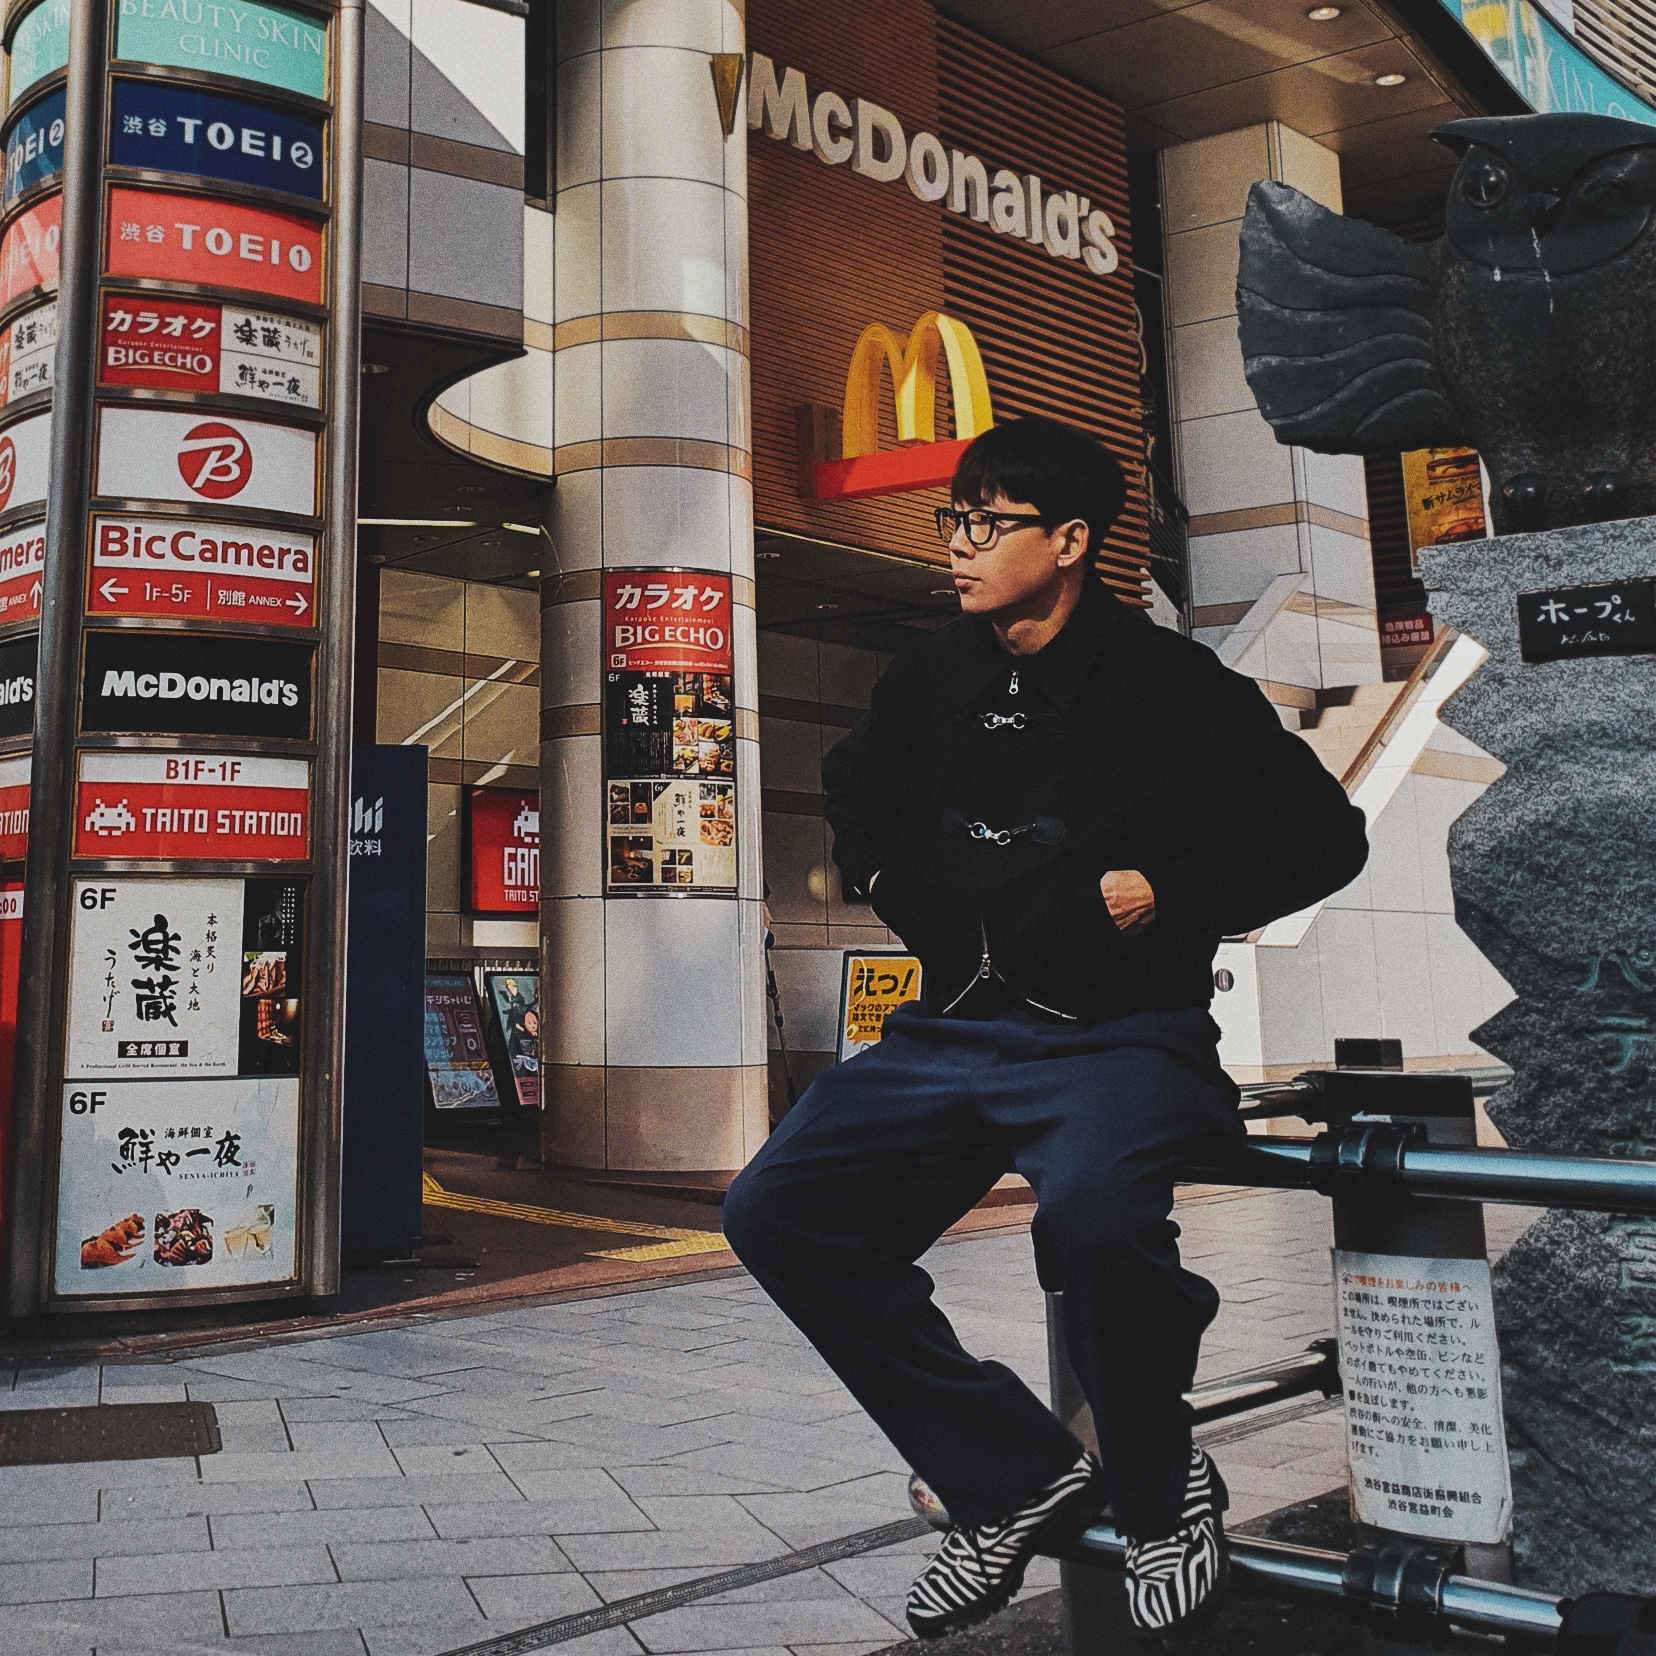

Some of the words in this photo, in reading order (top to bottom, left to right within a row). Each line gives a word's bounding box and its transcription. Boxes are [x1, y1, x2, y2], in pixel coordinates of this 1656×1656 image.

[257, 16, 321, 55] SKIN
[179, 34, 270, 69] CLINIC
[123, 115, 168, 137] 渋谷
[748, 51, 1119, 275] McDonald's
[119, 221, 165, 244] 渋谷
[107, 310, 216, 338] カラオケ
[107, 346, 150, 367] BIG
[153, 351, 213, 374] ECHO
[100, 525, 309, 573] BicCamera
[144, 582, 193, 603] 1F-5F
[218, 582, 246, 606] 別館
[249, 595, 282, 607] ANNEX
[614, 584, 724, 611] カラオケ
[1537, 594, 1636, 624] ホープくん
[615, 625, 660, 648] BIG
[664, 626, 724, 650] ECHO
[101, 670, 299, 707] McDonald's
[608, 673, 621, 682] 6F
[165, 759, 242, 782] B1F-1F
[142, 808, 208, 833] TAITO
[216, 811, 301, 837] STATION
[354, 797, 383, 834] hi
[80, 888, 117, 910] 6F
[504, 890, 527, 902] TAITO
[206, 913, 218, 973] 本格炙り
[127, 914, 182, 1028] 楽蔵
[188, 950, 201, 1012] 海と大地
[125, 1042, 181, 1057] 全席個室
[69, 1092, 107, 1115] 6F
[111, 1126, 242, 1176] 鮮や一夜
